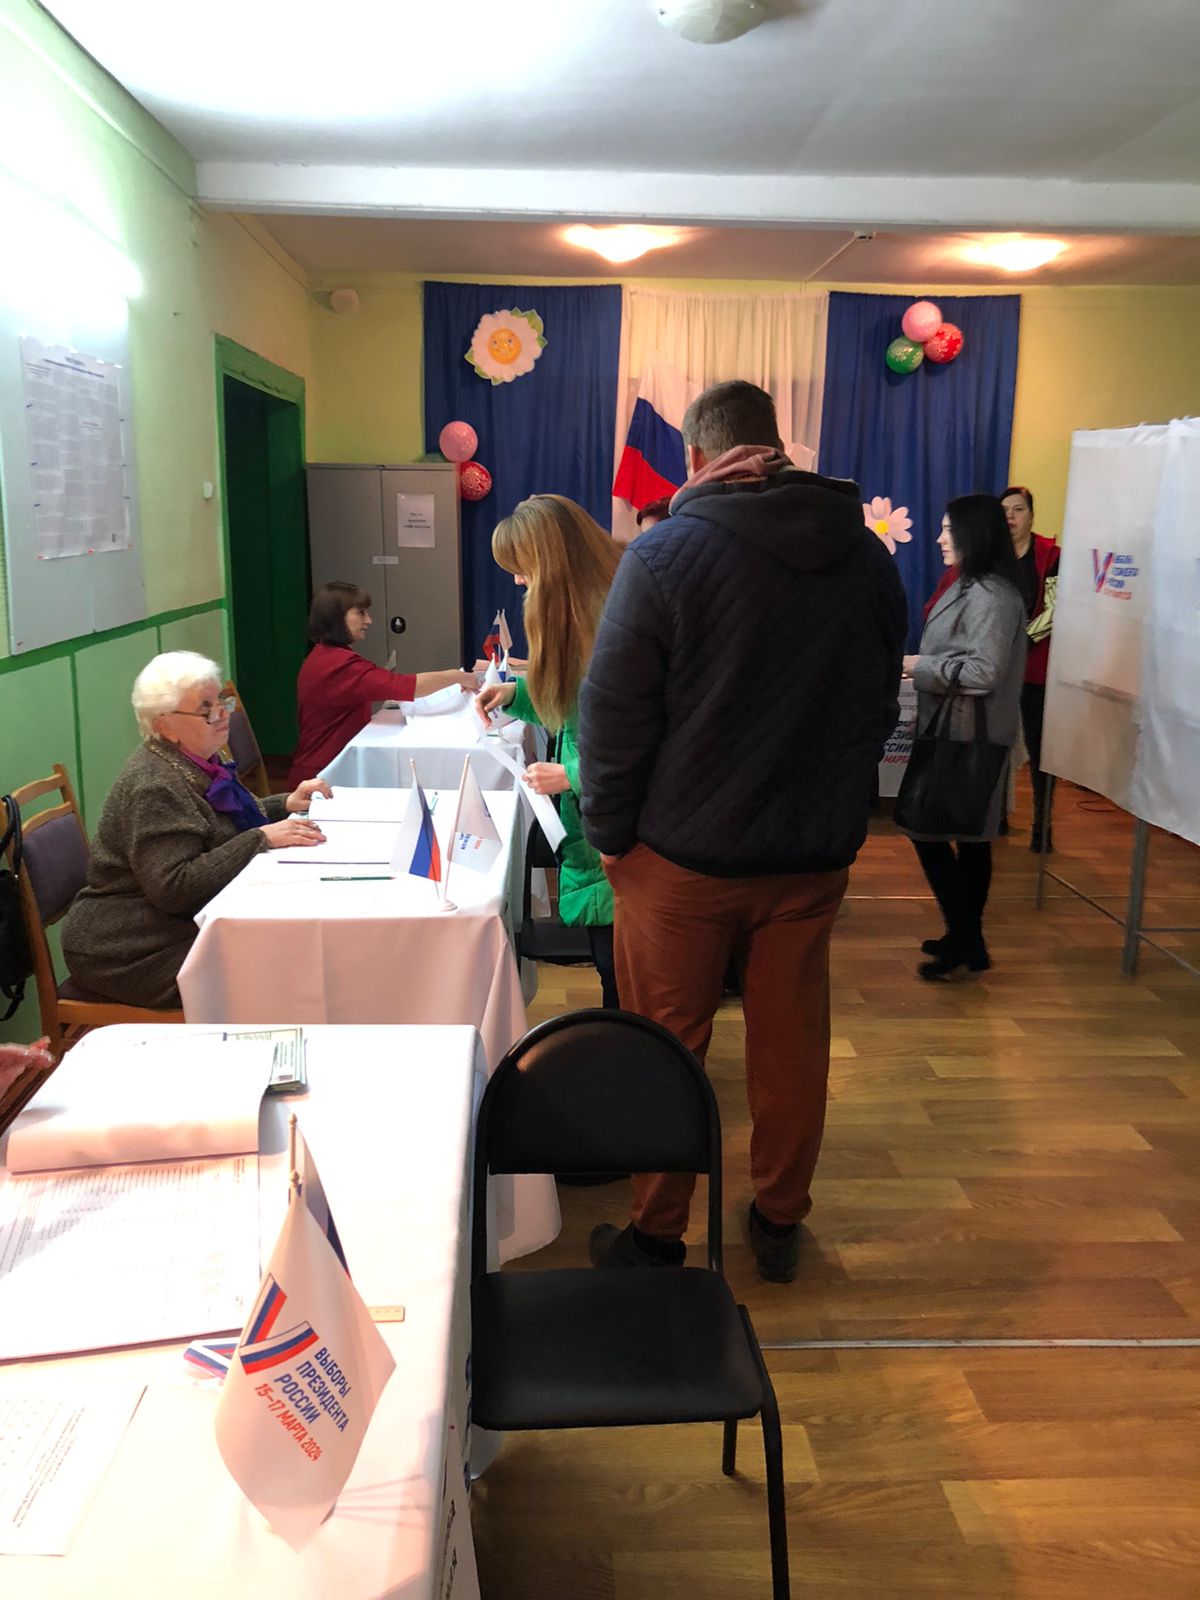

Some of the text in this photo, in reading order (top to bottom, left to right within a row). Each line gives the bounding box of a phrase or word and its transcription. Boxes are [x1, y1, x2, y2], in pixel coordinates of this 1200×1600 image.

[296, 1361, 350, 1432] ПРЕЗИДЕНТА
[315, 1347, 351, 1398] ВЫБОРЫ
[274, 1373, 321, 1424] РОССИИ
[277, 1410, 308, 1444] МАРТА
[300, 1437, 322, 1461] 2024
